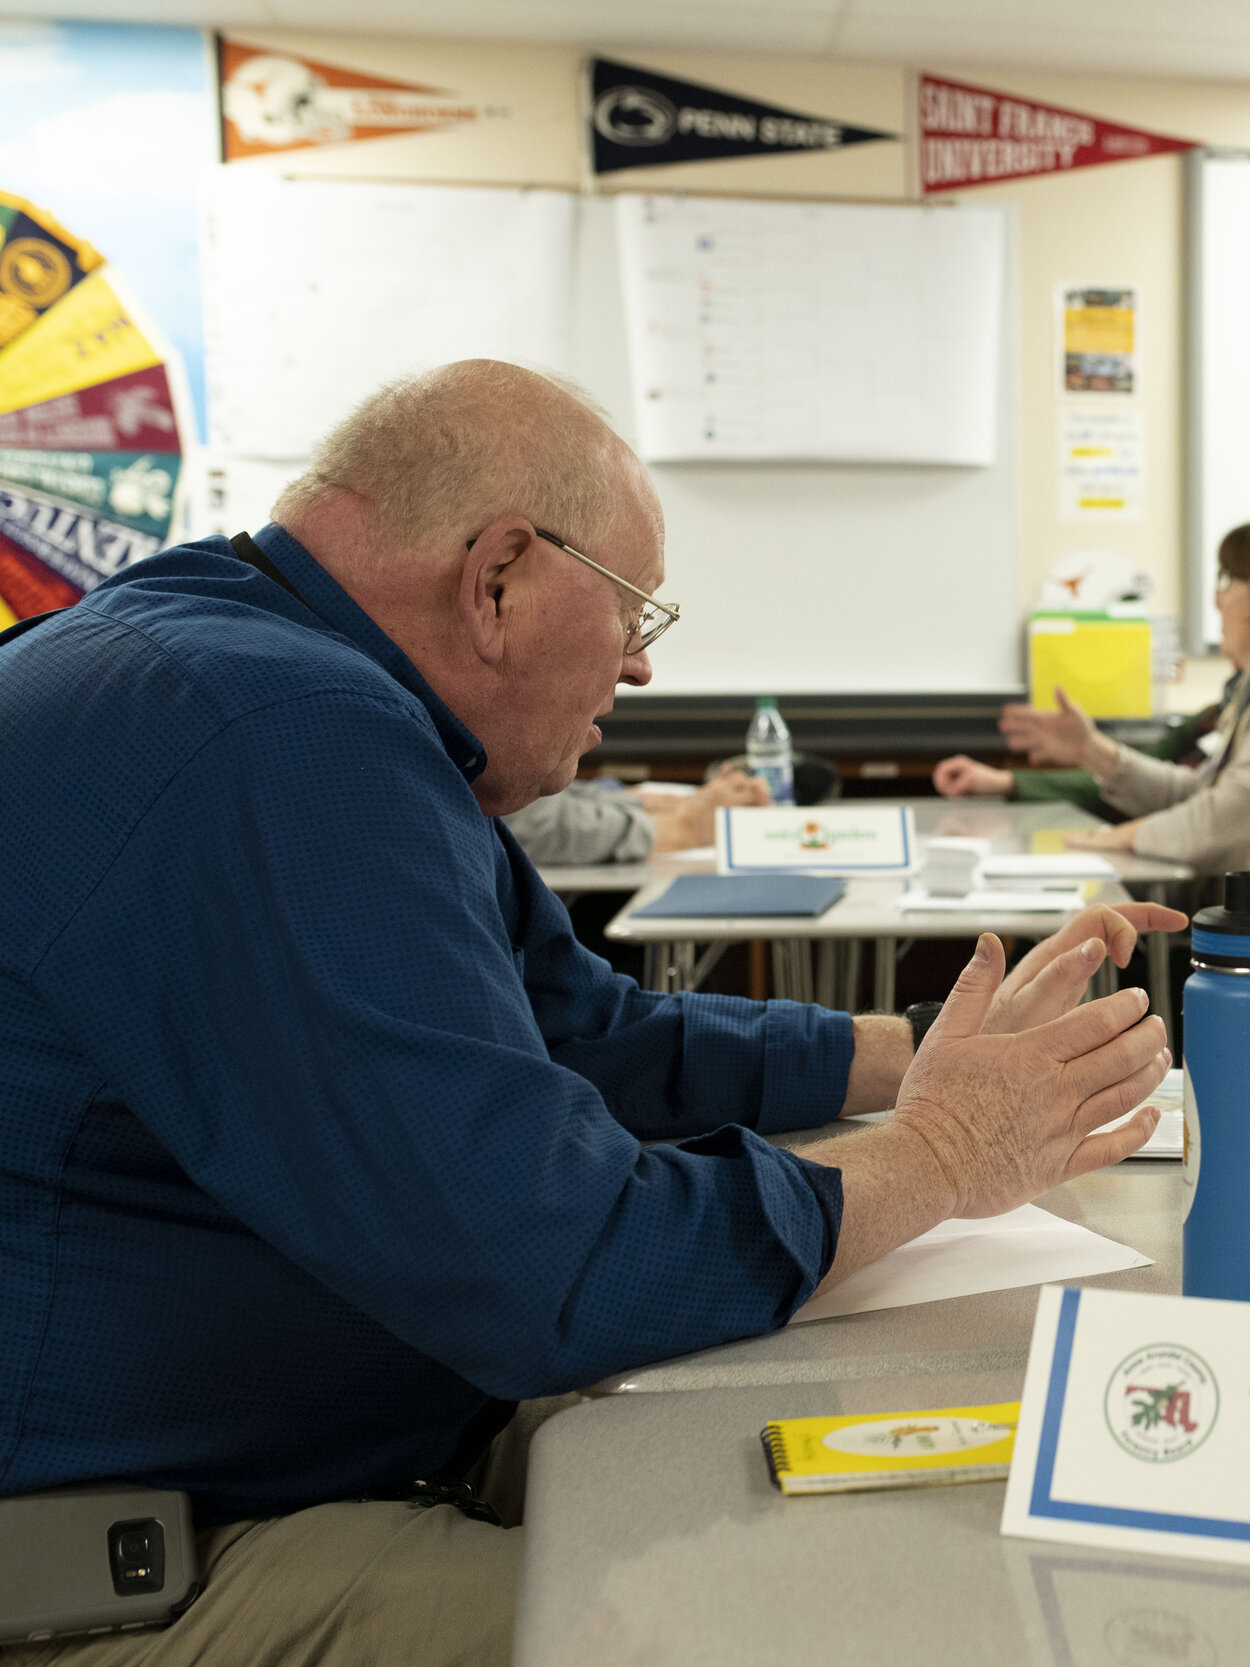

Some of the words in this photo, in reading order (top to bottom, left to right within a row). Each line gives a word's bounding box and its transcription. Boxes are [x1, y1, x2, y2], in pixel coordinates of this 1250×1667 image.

[678, 106, 756, 142] PENN
[758, 114, 842, 149] STATE
[922, 81, 994, 136] SAINT
[923, 138, 1079, 185] UNIVERSITY
